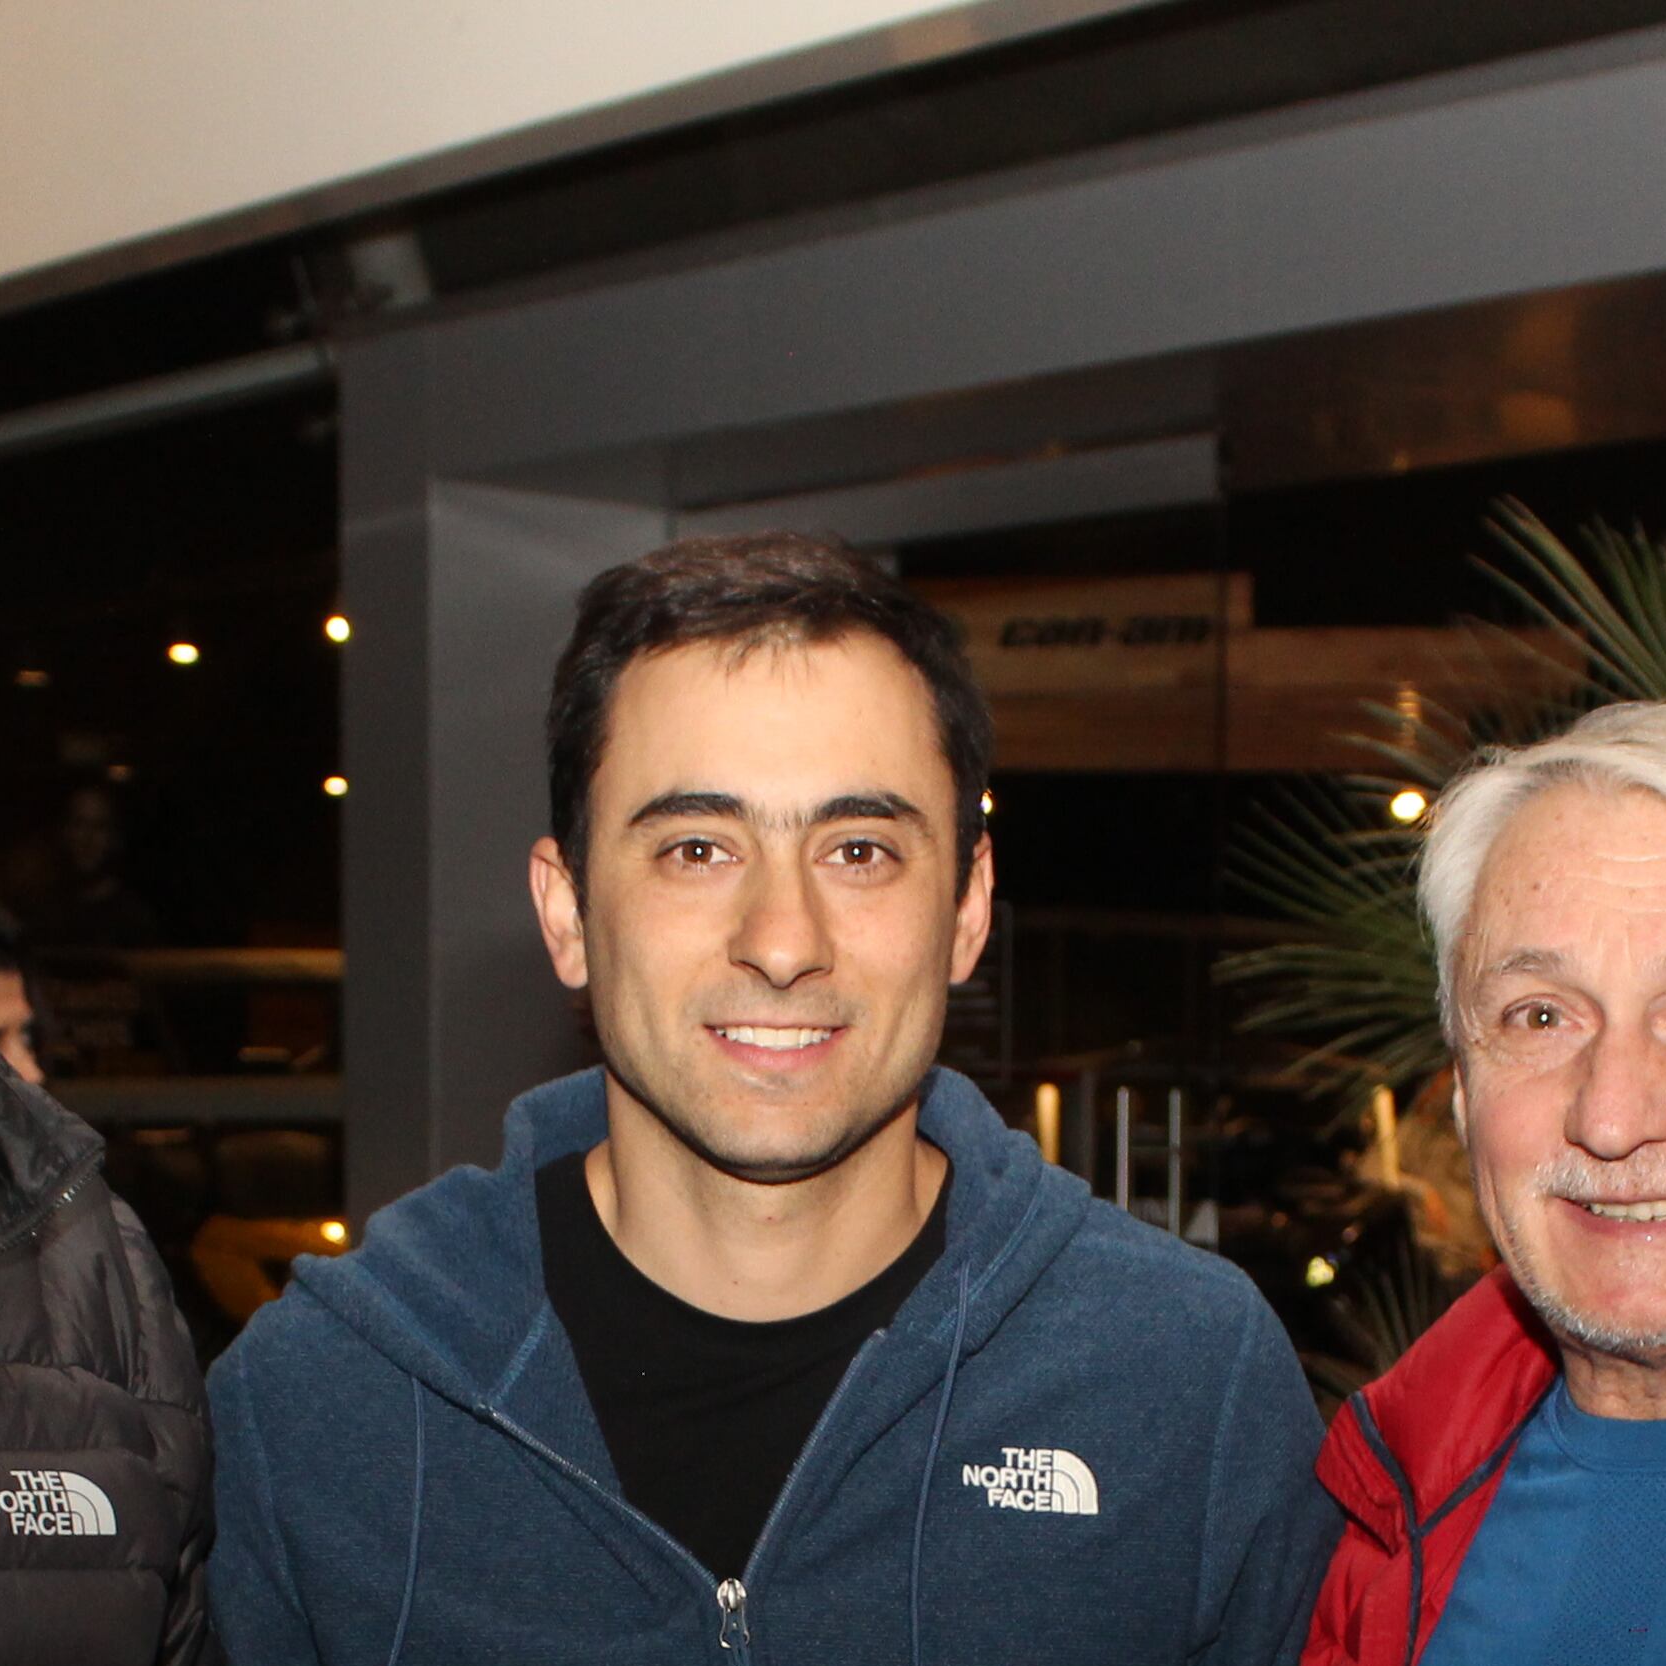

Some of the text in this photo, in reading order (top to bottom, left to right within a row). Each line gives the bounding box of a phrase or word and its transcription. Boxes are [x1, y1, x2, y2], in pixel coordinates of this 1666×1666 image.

[1001, 1447, 1053, 1471] THE
[10, 1470, 63, 1491] THE
[962, 1464, 1051, 1490] NORTH
[987, 1488, 1052, 1512] FACE
[10, 1512, 73, 1535] FACE
